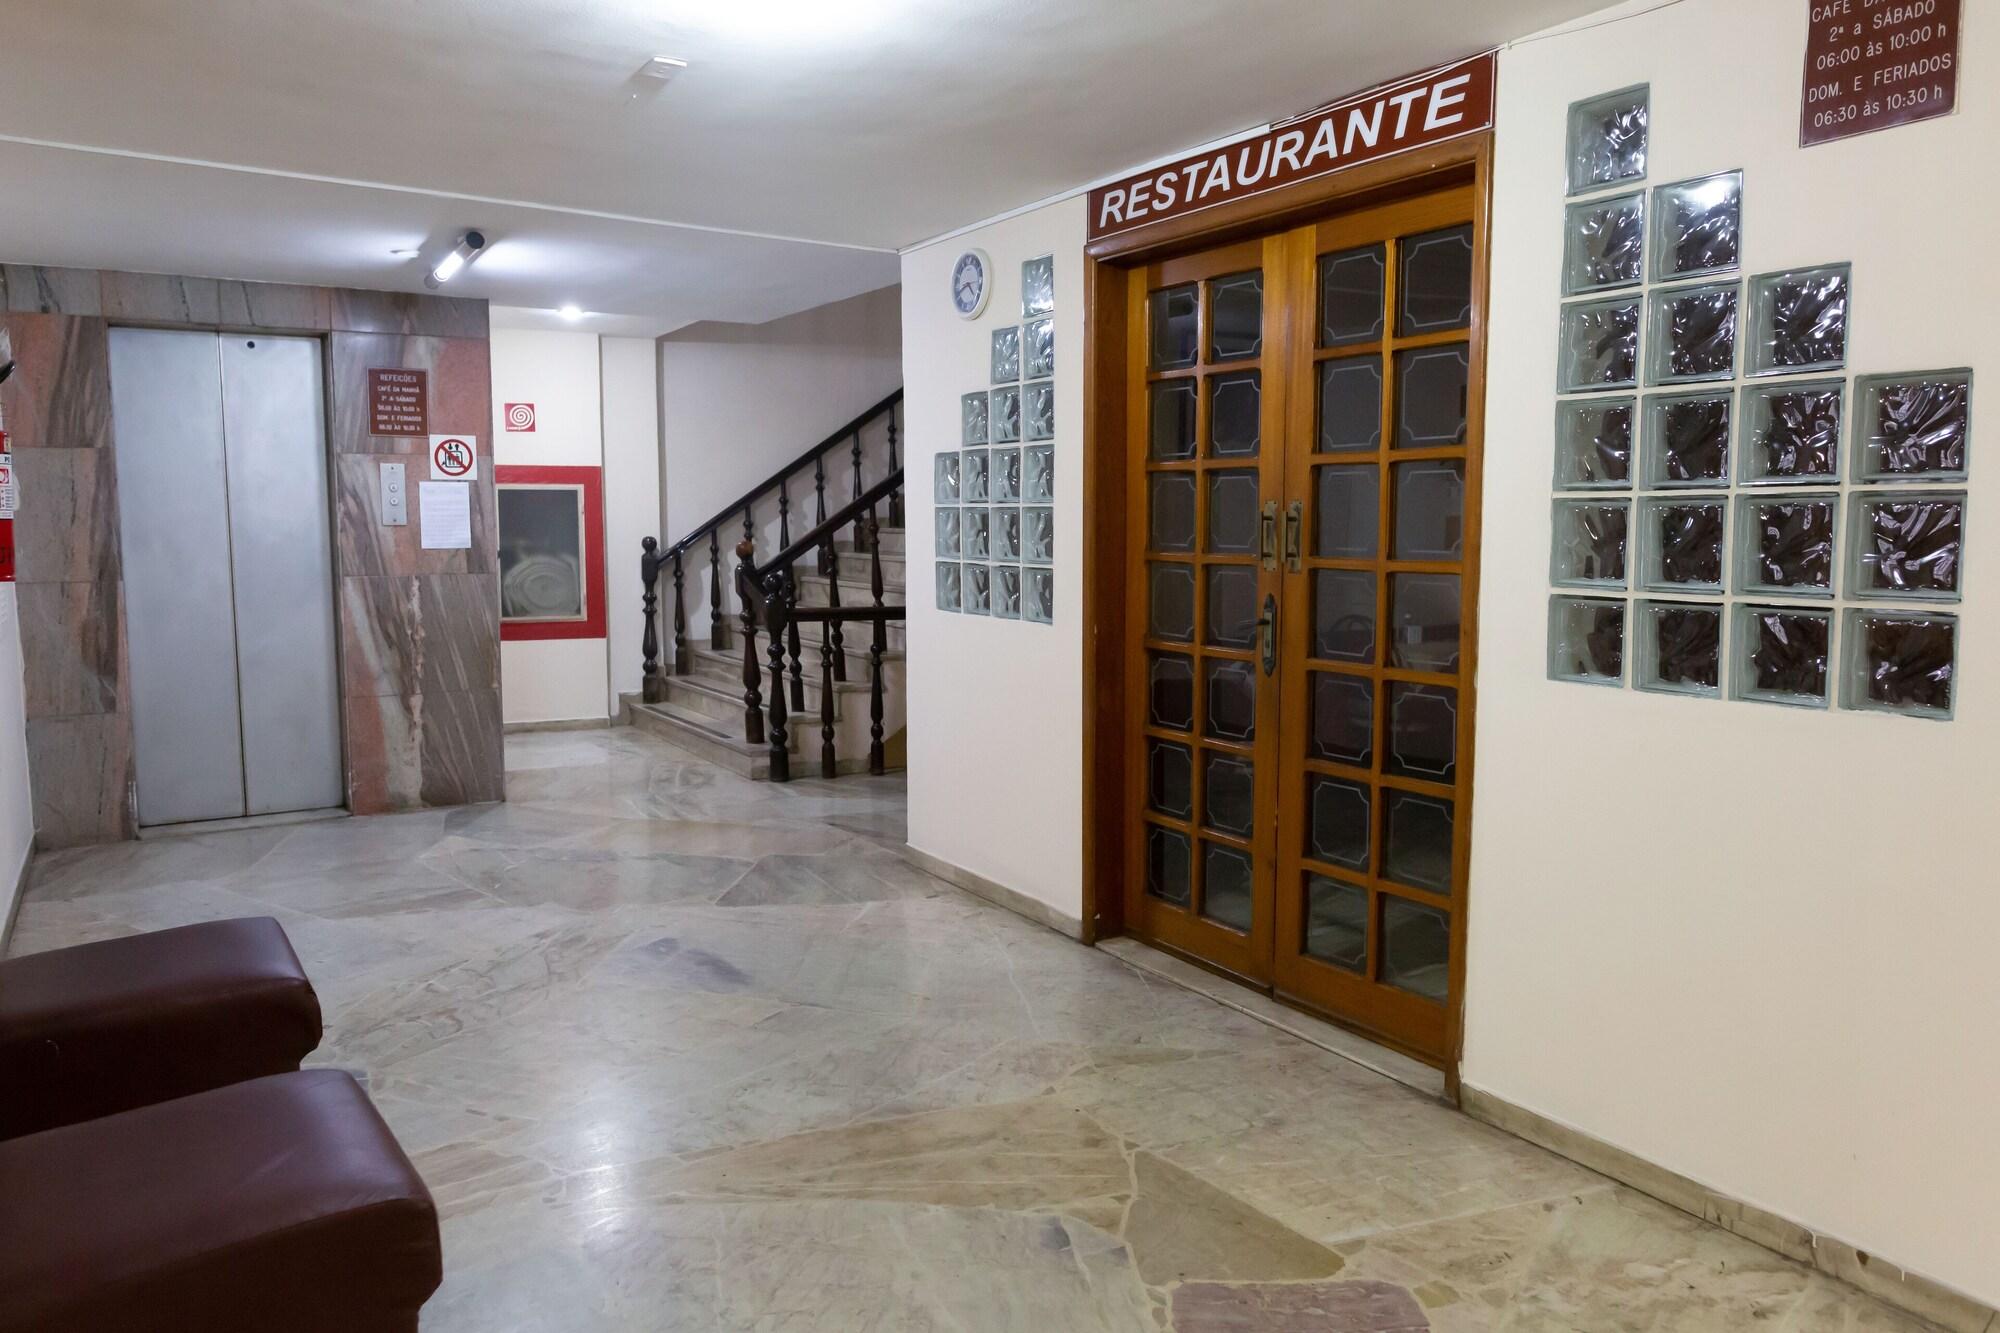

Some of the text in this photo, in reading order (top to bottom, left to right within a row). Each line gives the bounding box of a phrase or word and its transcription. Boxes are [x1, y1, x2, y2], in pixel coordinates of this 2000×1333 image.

[1853, 23, 1862, 35] a
[1872, 0, 1935, 29] SÁBADO
[1816, 23, 1947, 70] 06:00 às 10:00 h
[1808, 53, 1951, 103] DOM. E FERIADOS
[1814, 84, 1943, 128] 06:30 às 10:30 h
[1099, 73, 1471, 229] RESTAURANTE
